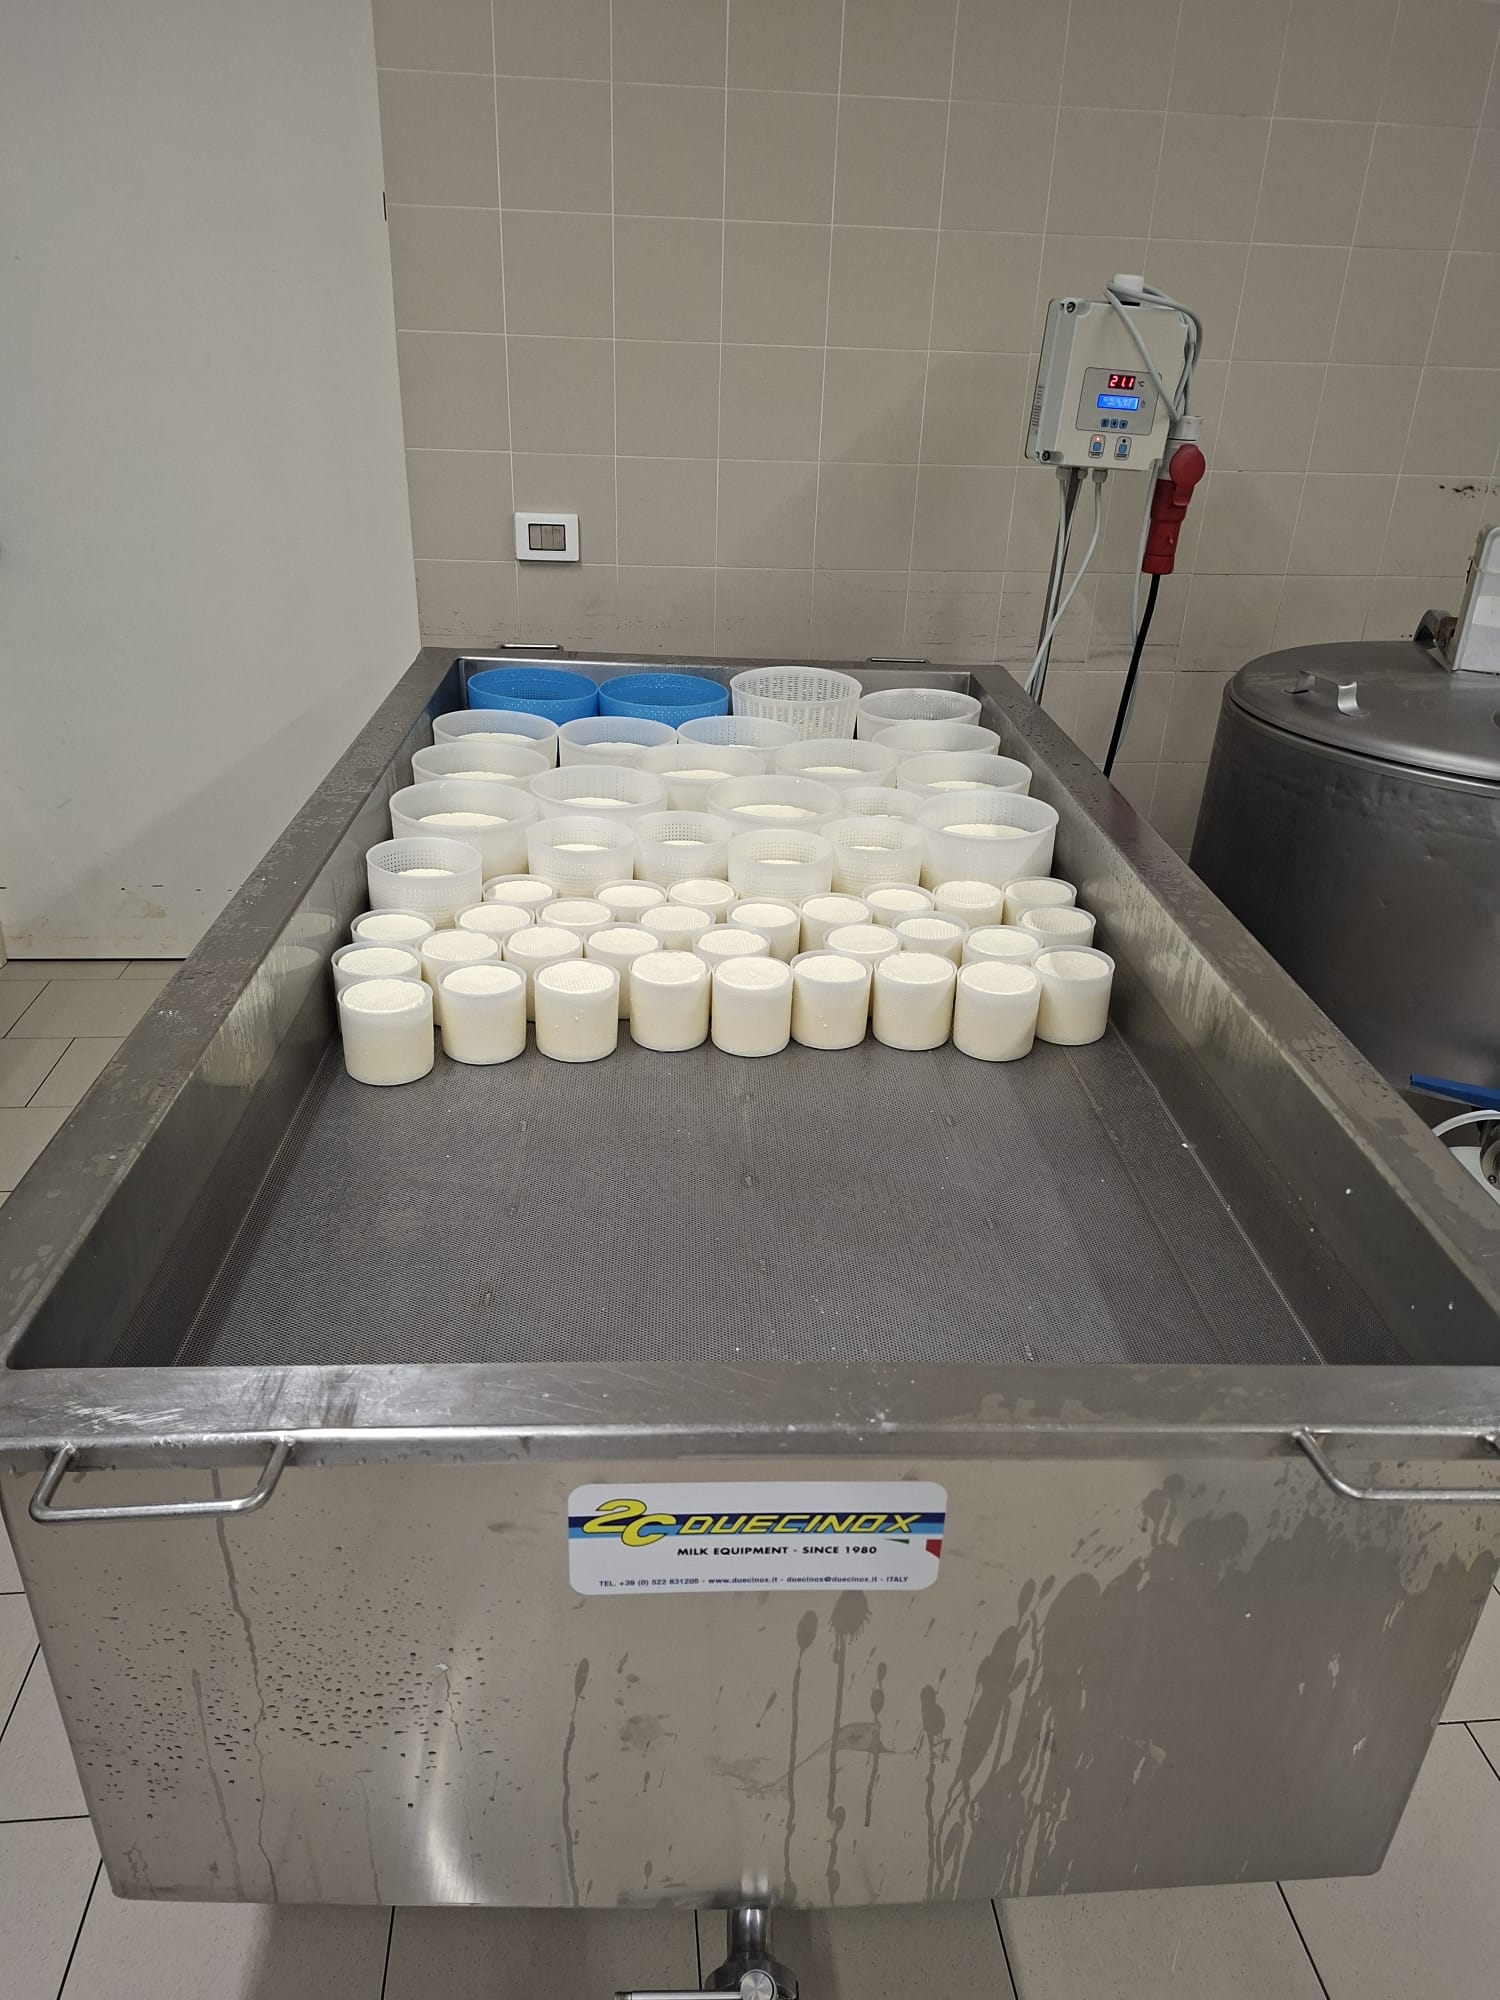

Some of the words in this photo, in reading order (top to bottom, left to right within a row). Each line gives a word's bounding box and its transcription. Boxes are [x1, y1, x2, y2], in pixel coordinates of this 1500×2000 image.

[678, 1514, 921, 1535] DUECINOX
[677, 1547, 709, 1556] MILK
[713, 1546, 788, 1556] EQUIPMENT
[802, 1545, 840, 1555] SINCE
[844, 1545, 878, 1554] 1980
[638, 1579, 649, 1587] (0)
[708, 1576, 778, 1584] www.duecinox.it
